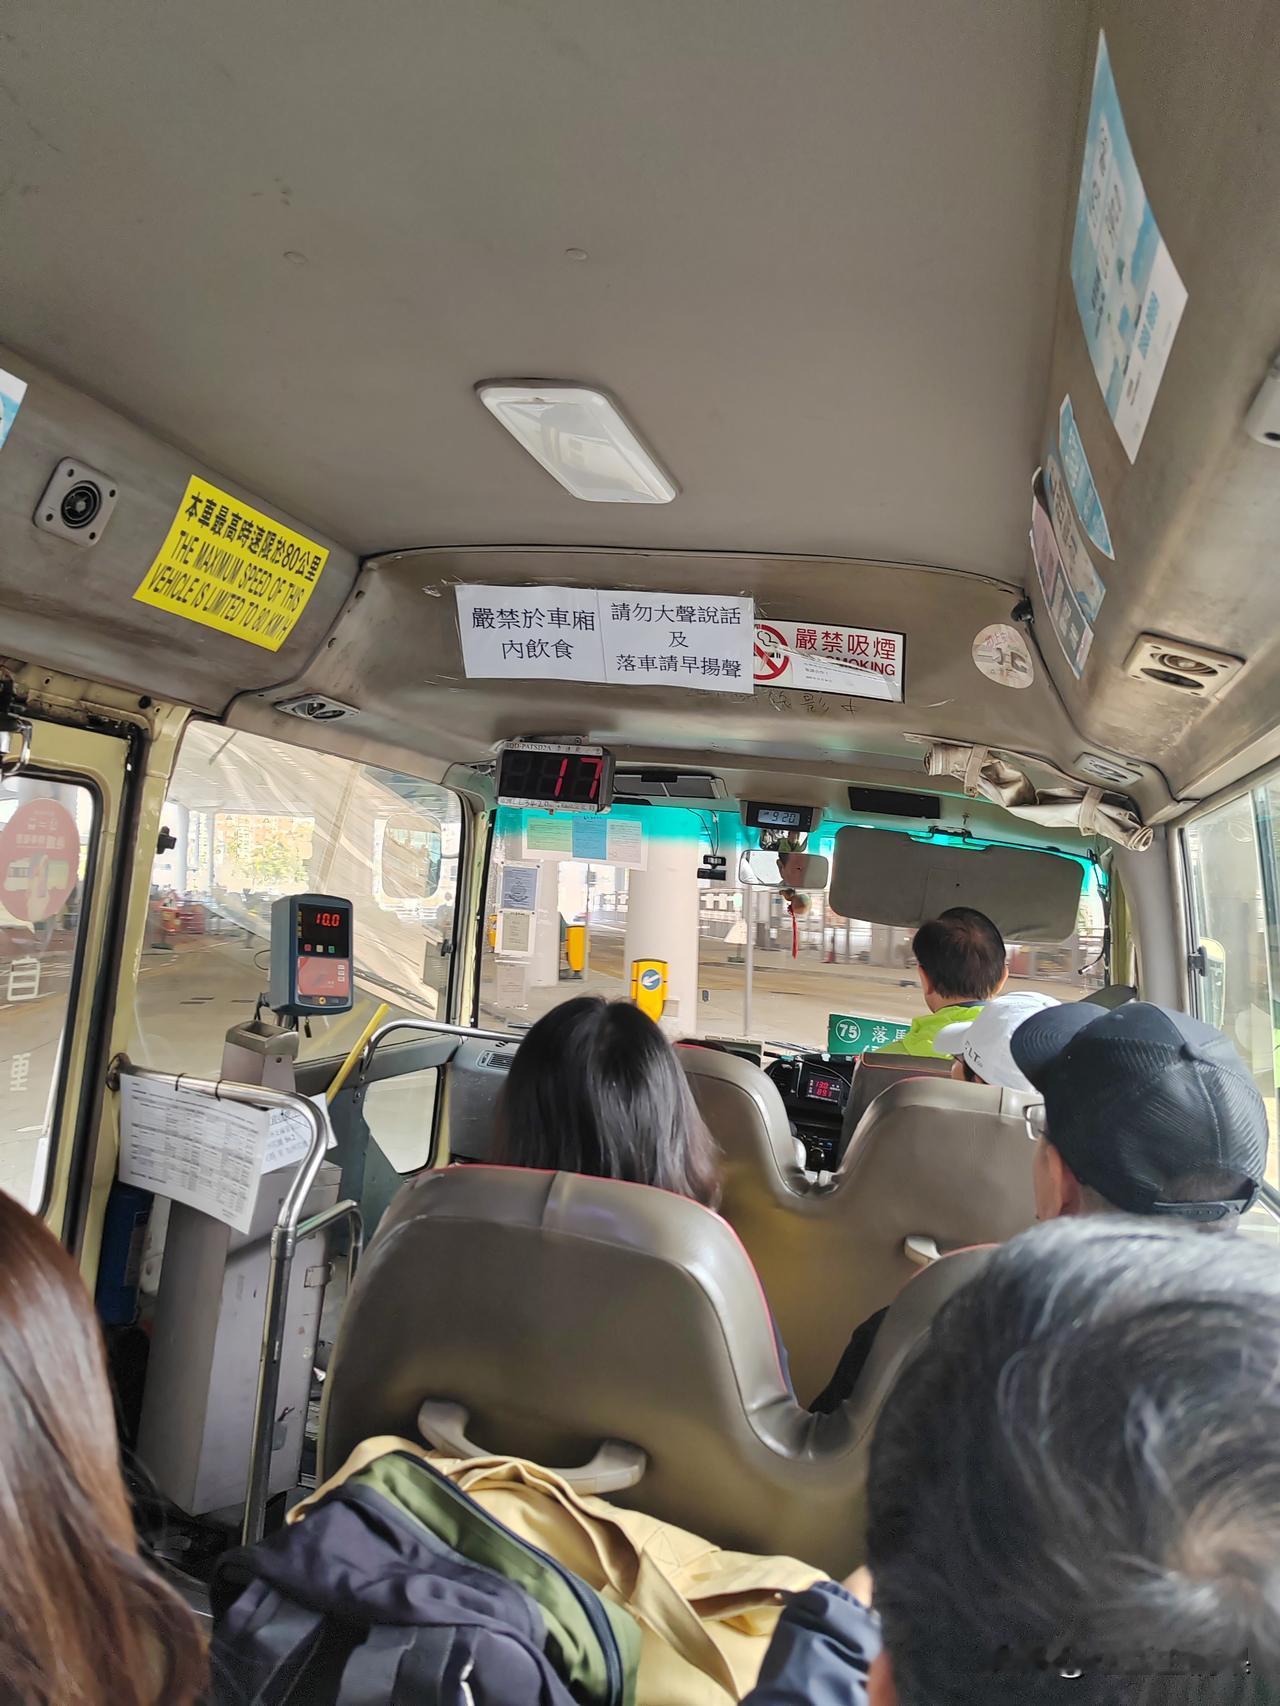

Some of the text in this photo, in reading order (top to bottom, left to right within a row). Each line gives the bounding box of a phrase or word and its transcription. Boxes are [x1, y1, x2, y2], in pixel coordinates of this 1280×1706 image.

[171, 530, 305, 612] THE MAXIMUM SPEED OF THIS
[147, 562, 201, 604] VEHICLE
[190, 582, 211, 608] IS
[202, 586, 246, 622] LIMITED
[238, 601, 260, 627] TO
[472, 607, 596, 632] 嚴禁於車廂
[610, 602, 742, 626] 請勿大聲說話
[502, 639, 575, 660] 內飲食
[668, 631, 689, 648] 及
[795, 627, 897, 661] 嚴禁吸煙
[616, 654, 742, 679] 落車請早揚聲
[554, 757, 604, 800] 17
[316, 912, 340, 927] 10.0
[839, 1023, 858, 1040] 75
